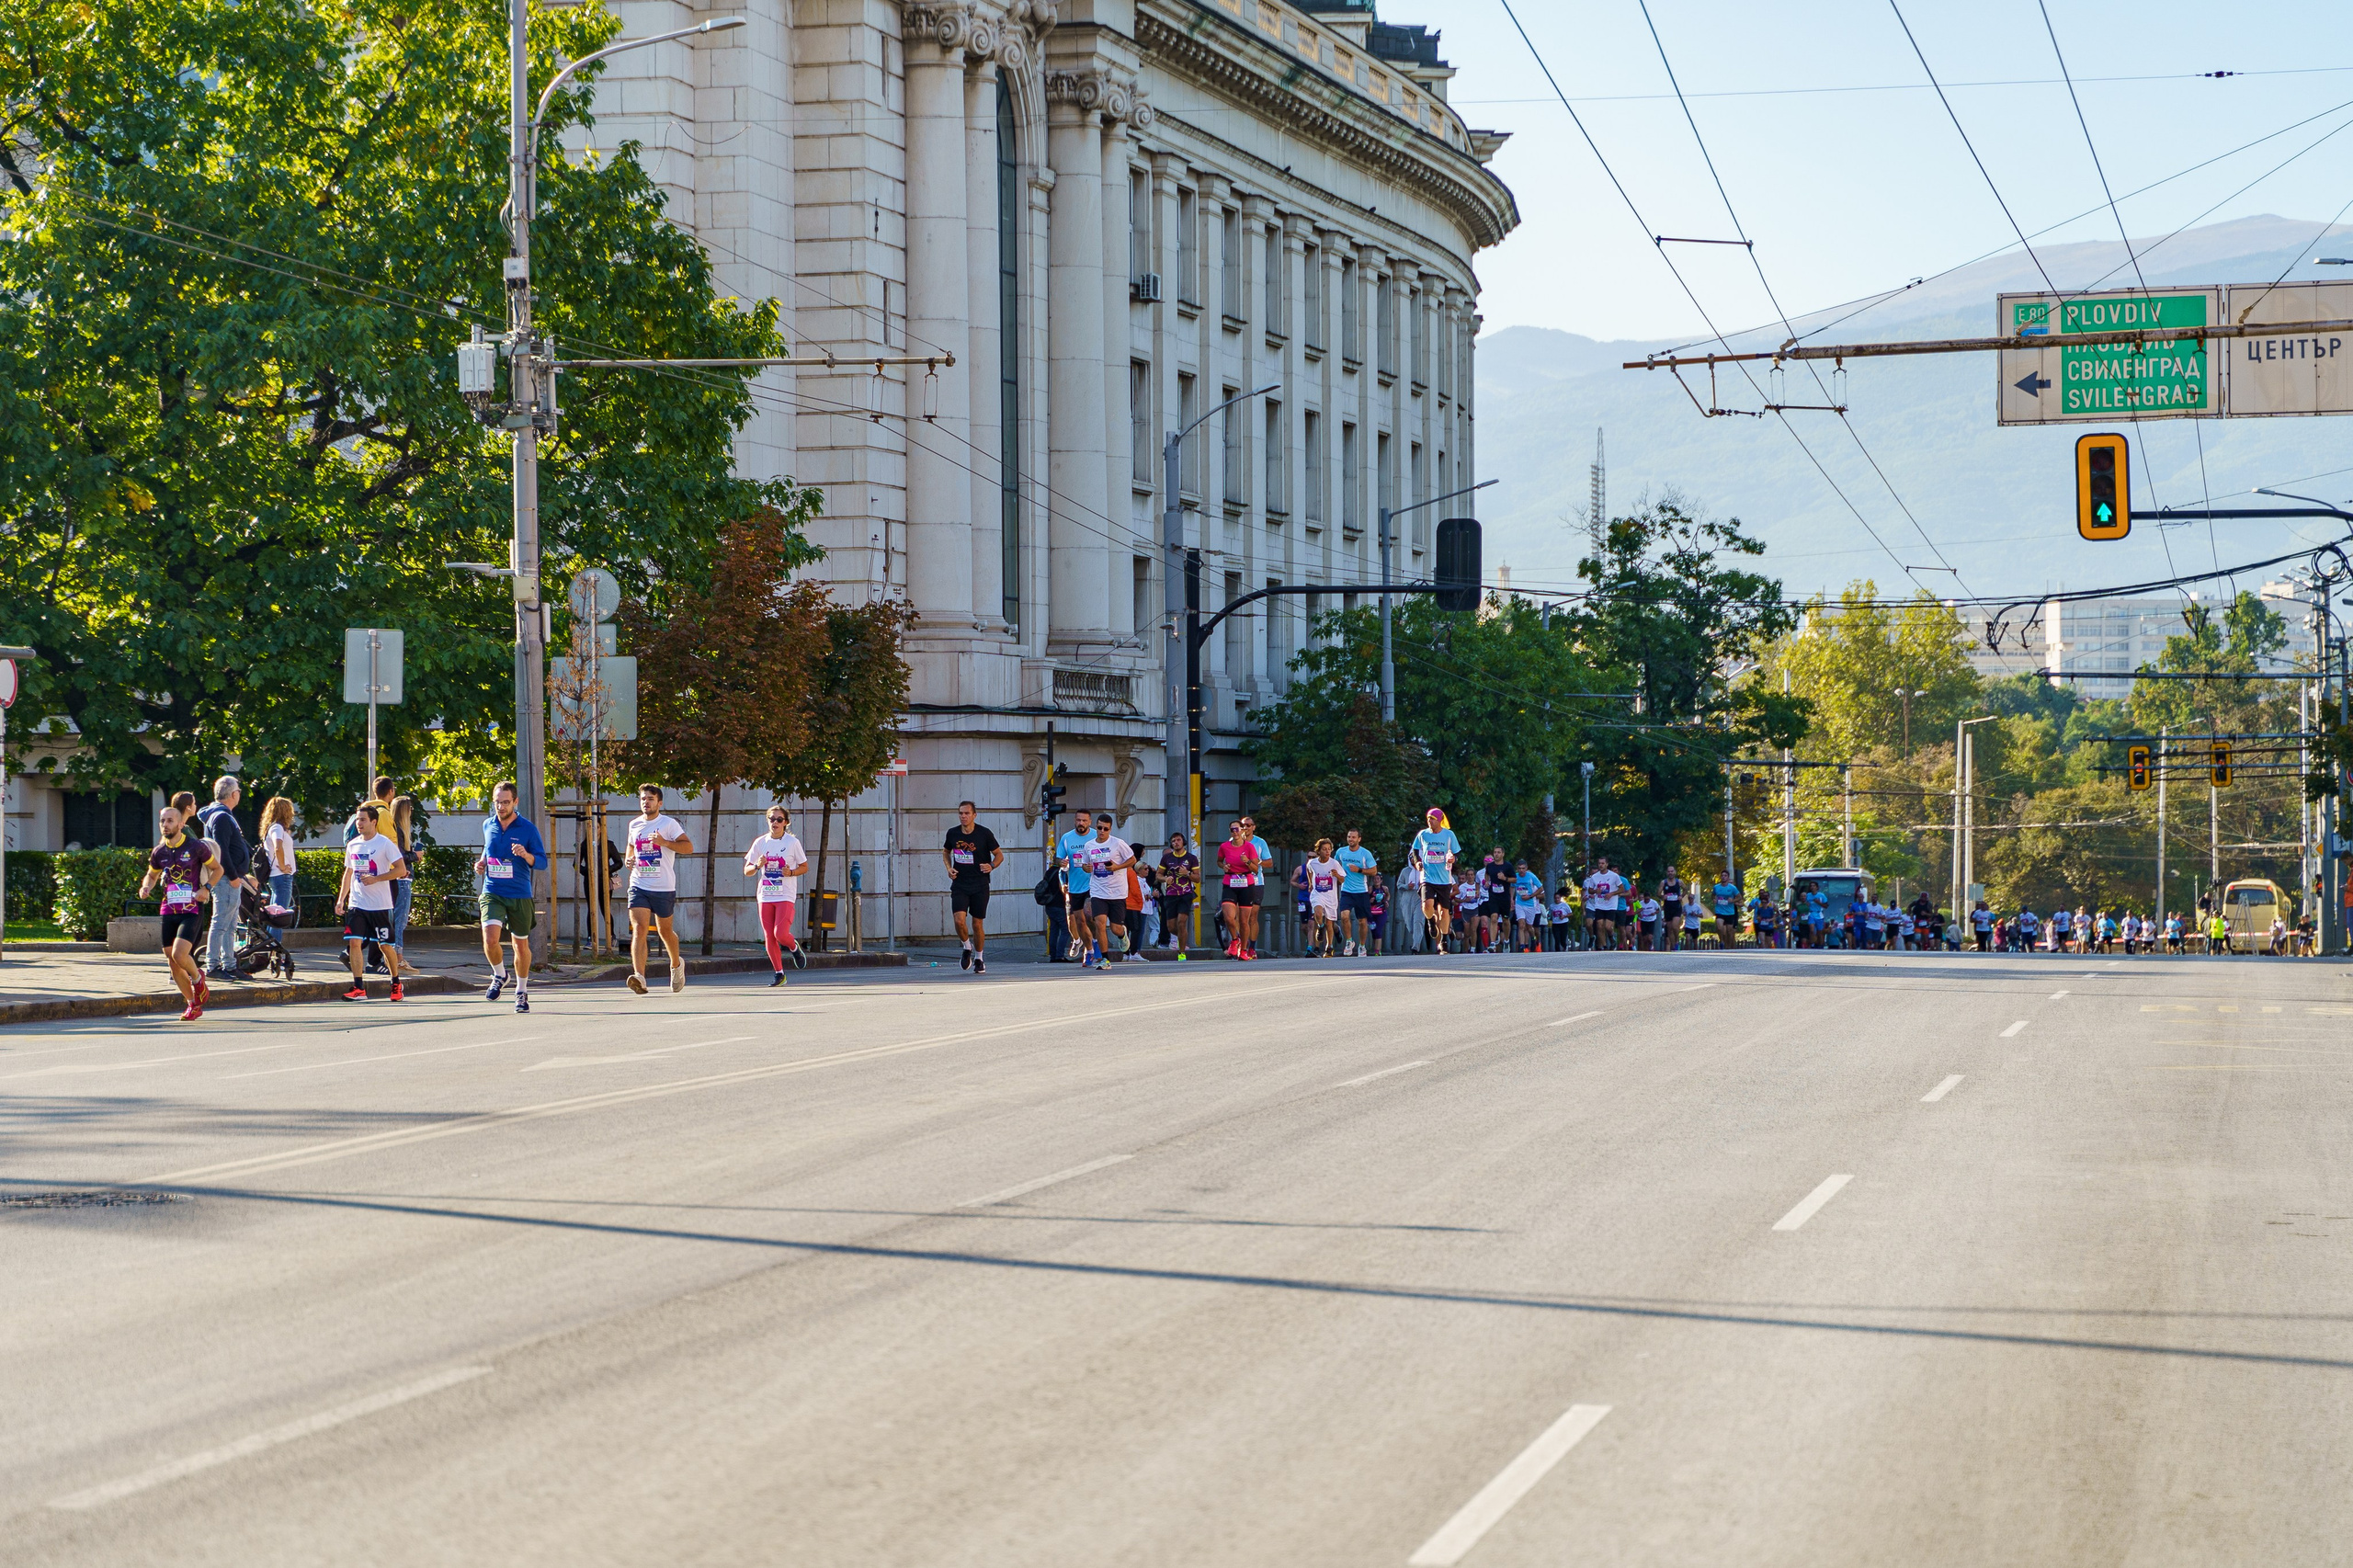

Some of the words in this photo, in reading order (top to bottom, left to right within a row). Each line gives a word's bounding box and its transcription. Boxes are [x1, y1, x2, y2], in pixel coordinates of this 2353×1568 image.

[2067, 302, 2162, 325] PLOVDIV
[2247, 337, 2341, 363] ЦЕНТЪР
[2068, 356, 2200, 381] СВИЛЕНГРАД
[2069, 384, 2199, 408] SVILENGRAD
[375, 927, 389, 940] 13
